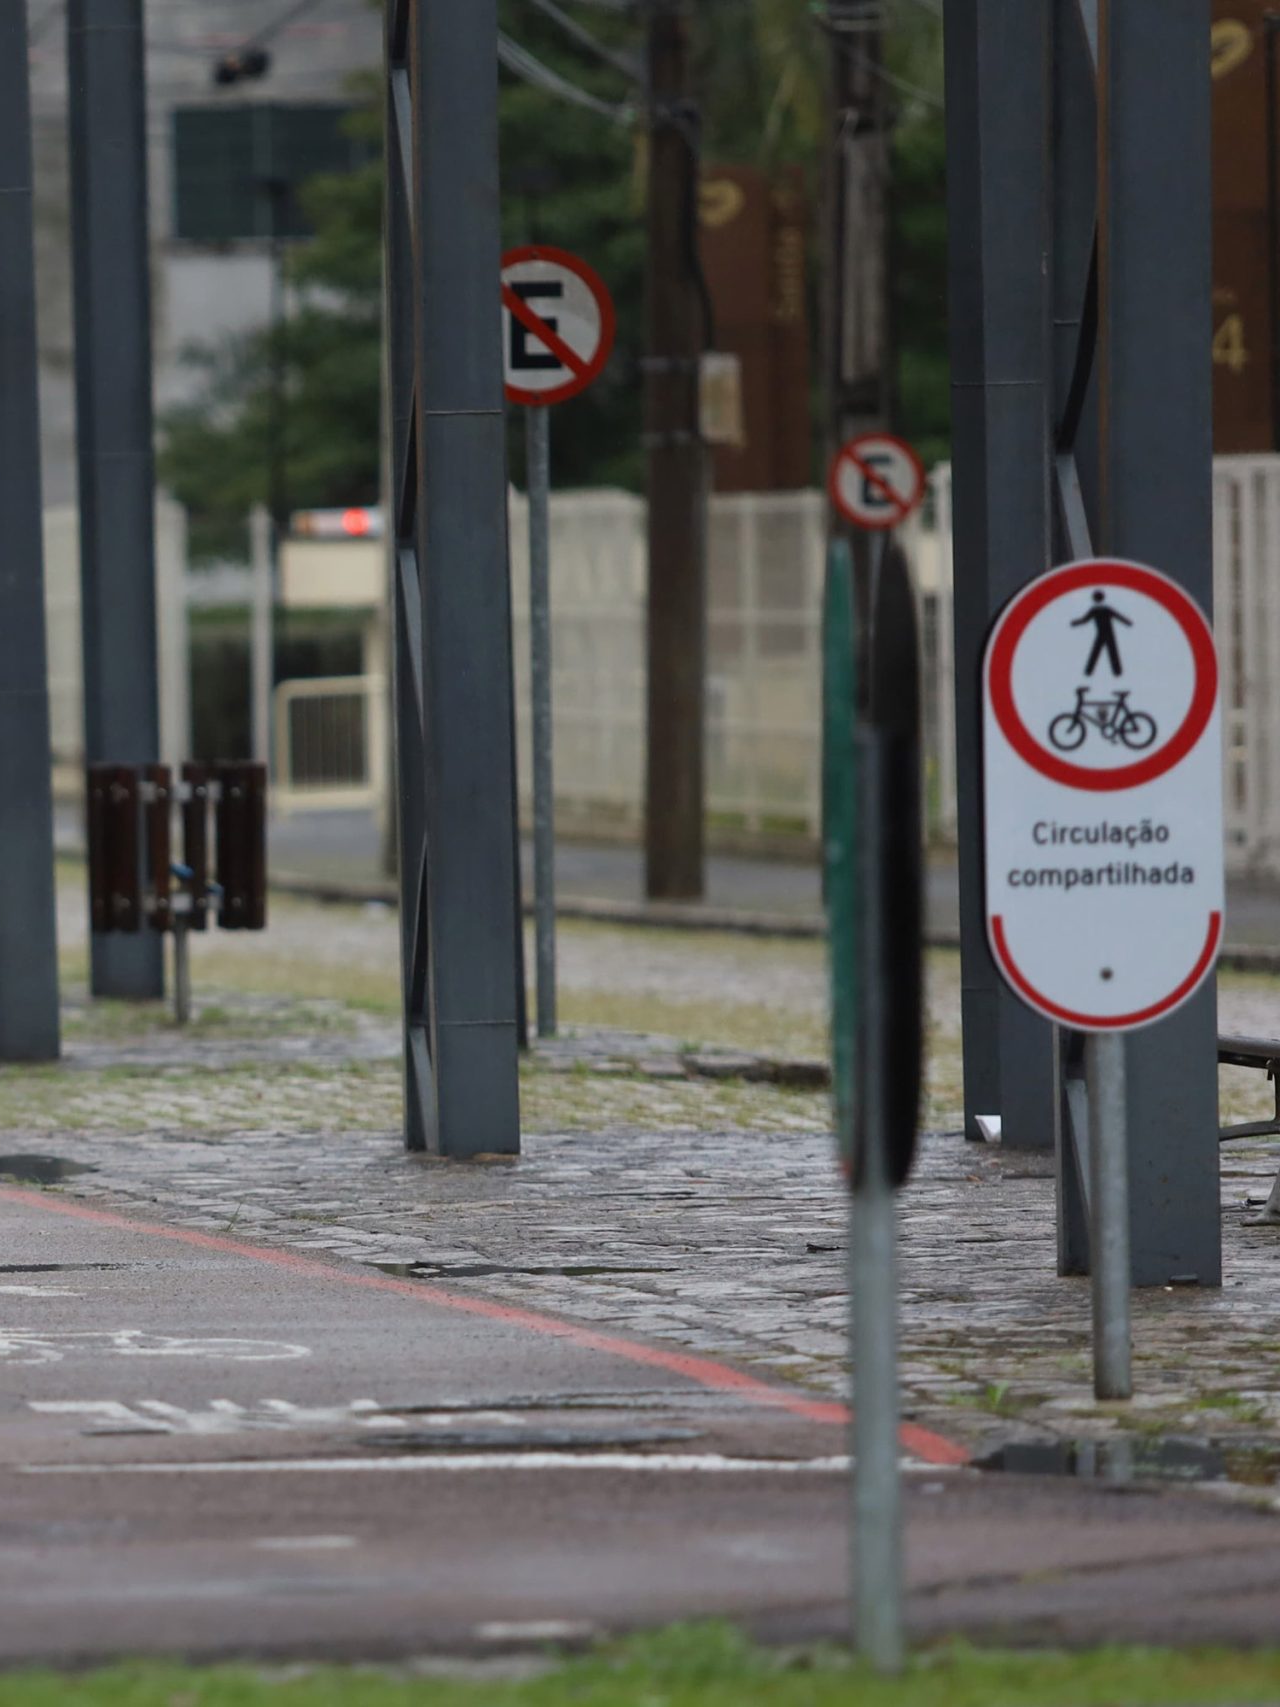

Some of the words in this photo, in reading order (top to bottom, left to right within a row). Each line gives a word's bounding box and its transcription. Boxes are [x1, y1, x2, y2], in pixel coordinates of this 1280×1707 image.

[510, 281, 563, 370] E
[862, 454, 894, 508] E
[1032, 819, 1170, 849] Circulação
[1007, 861, 1195, 891] compartilhada
